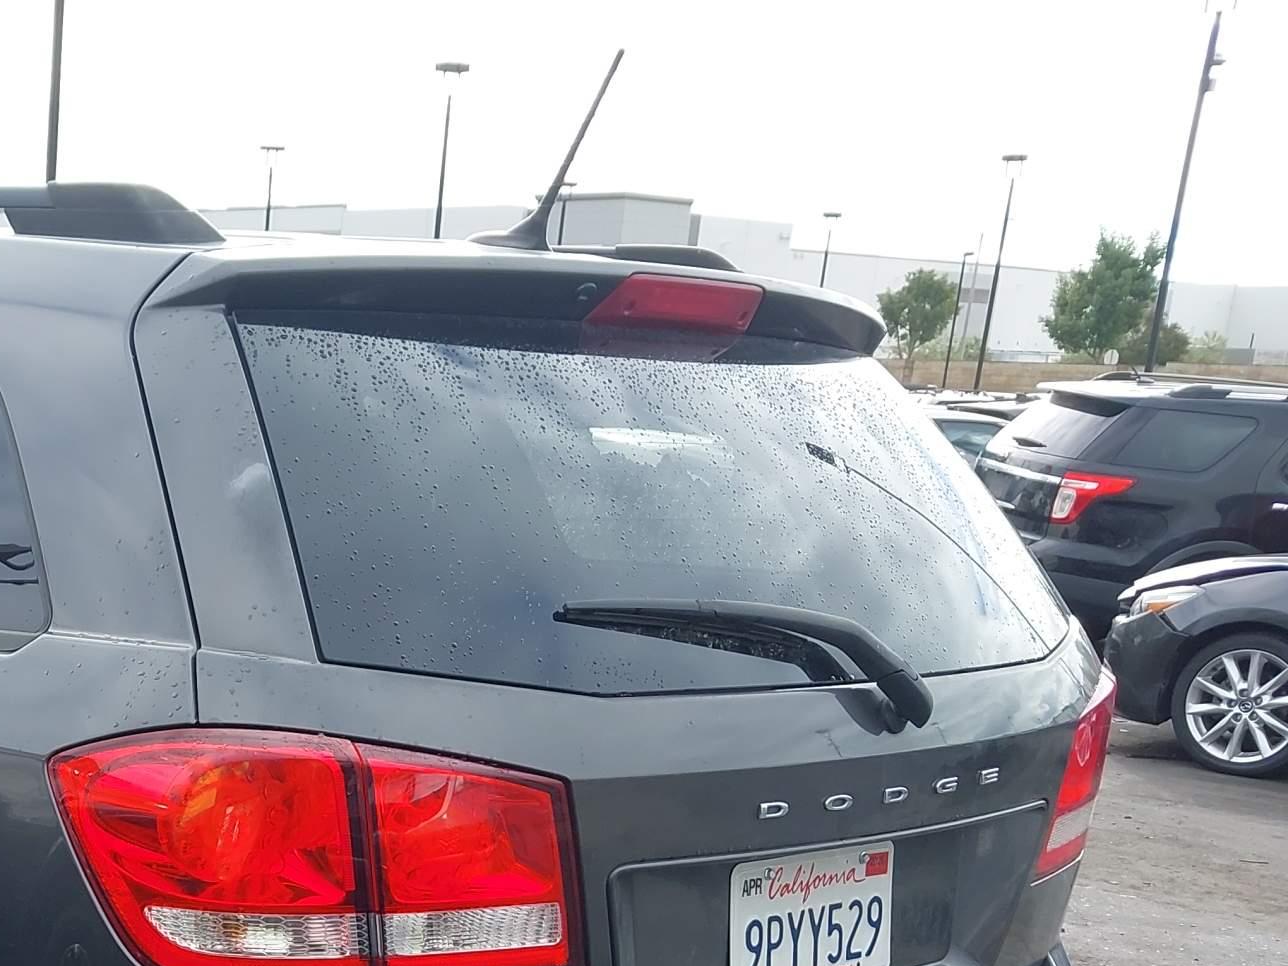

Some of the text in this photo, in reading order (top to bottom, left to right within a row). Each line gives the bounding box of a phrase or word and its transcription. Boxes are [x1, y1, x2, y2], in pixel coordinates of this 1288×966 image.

[759, 767, 1000, 819] DODGE
[741, 877, 763, 898] APR
[767, 862, 865, 904] California
